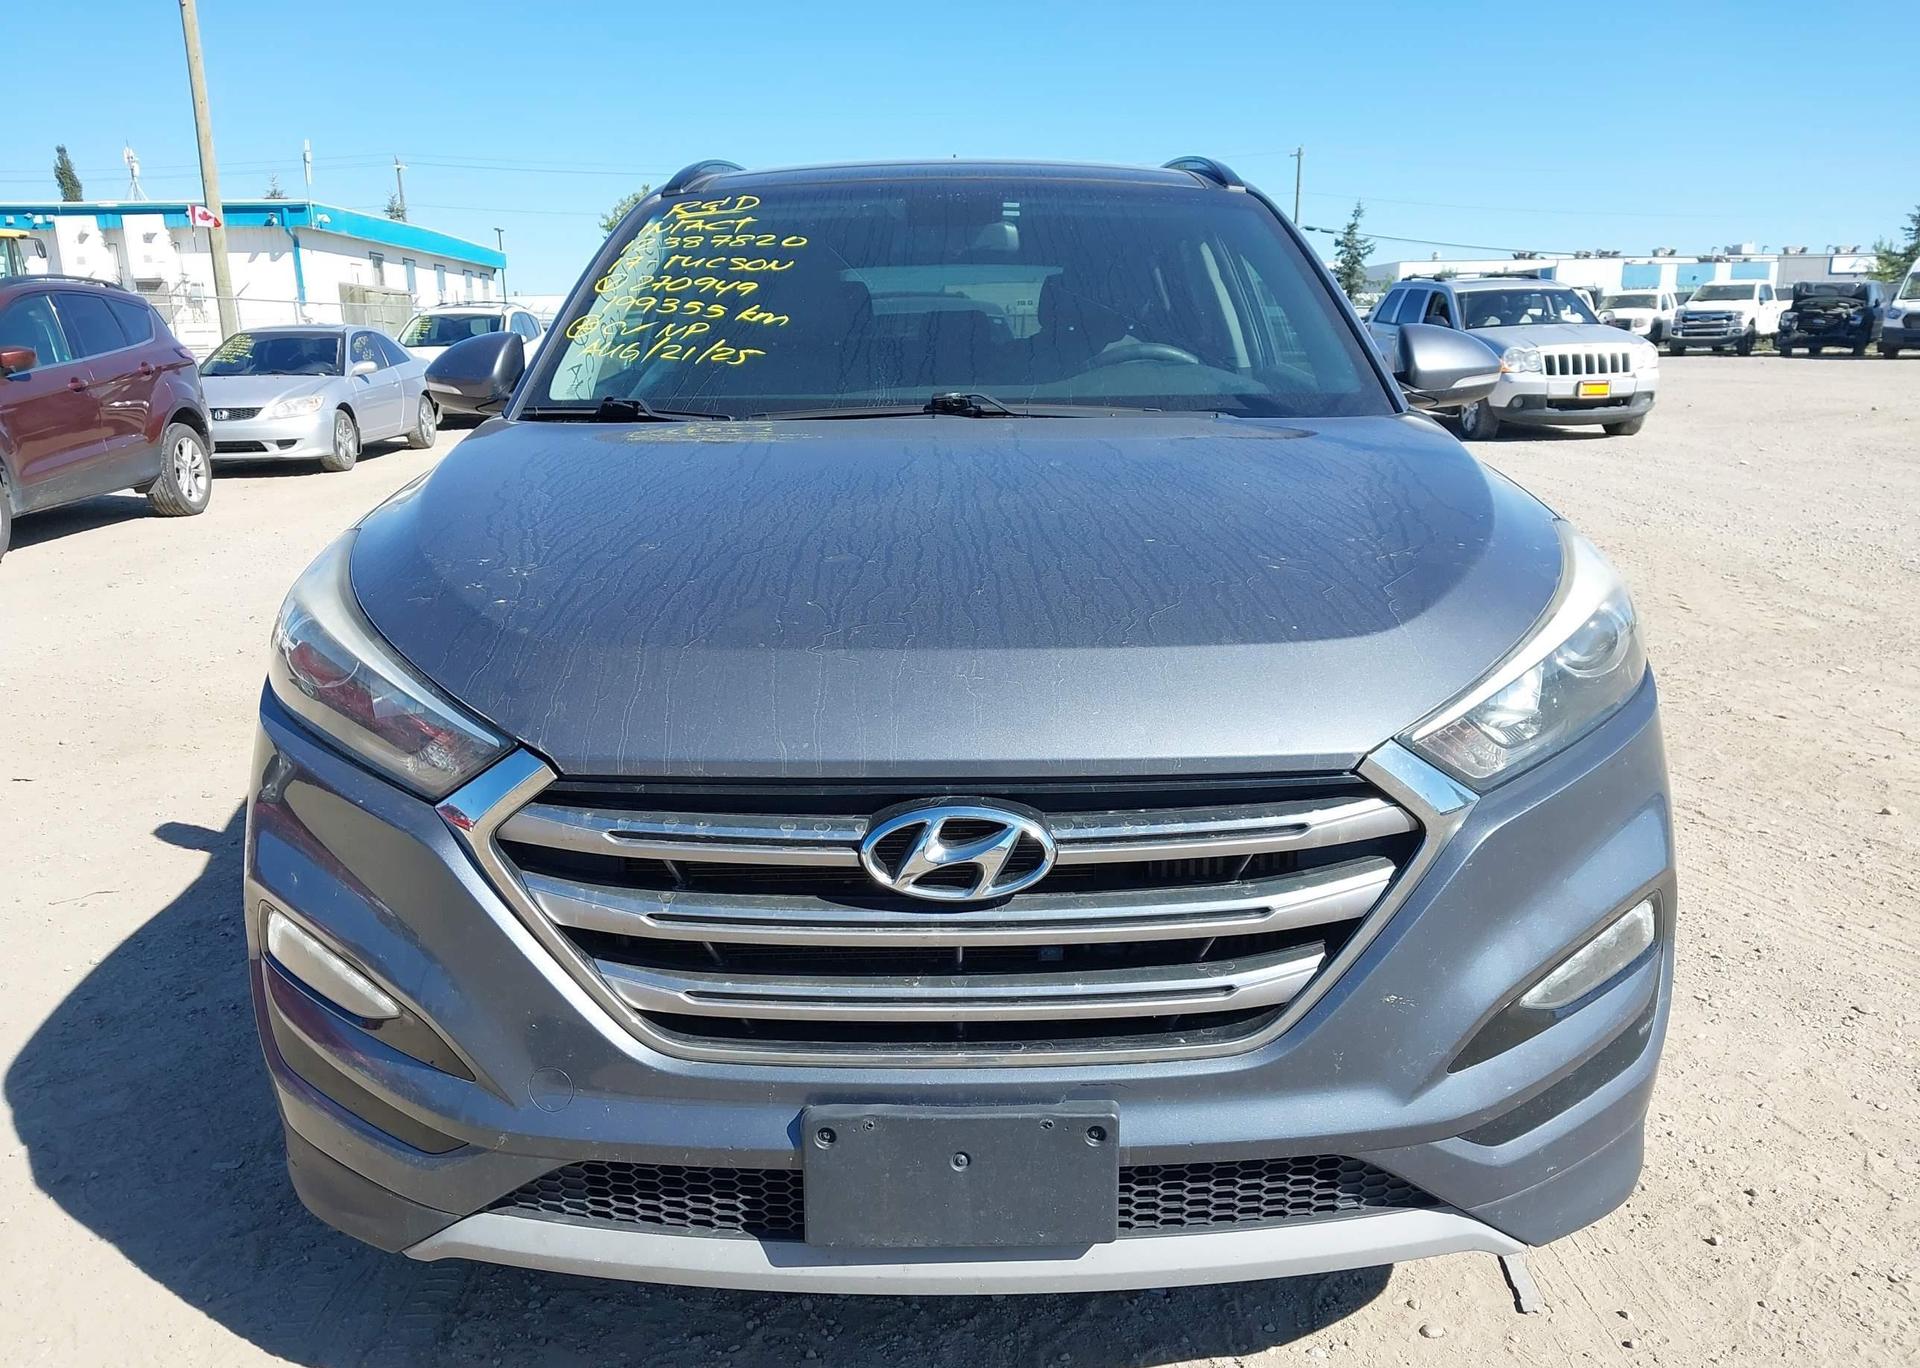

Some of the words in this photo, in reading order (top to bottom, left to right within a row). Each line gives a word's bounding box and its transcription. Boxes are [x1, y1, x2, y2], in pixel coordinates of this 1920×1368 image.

[629, 275, 759, 298] 270949
[602, 295, 729, 318] 199355
[734, 304, 789, 327] km
